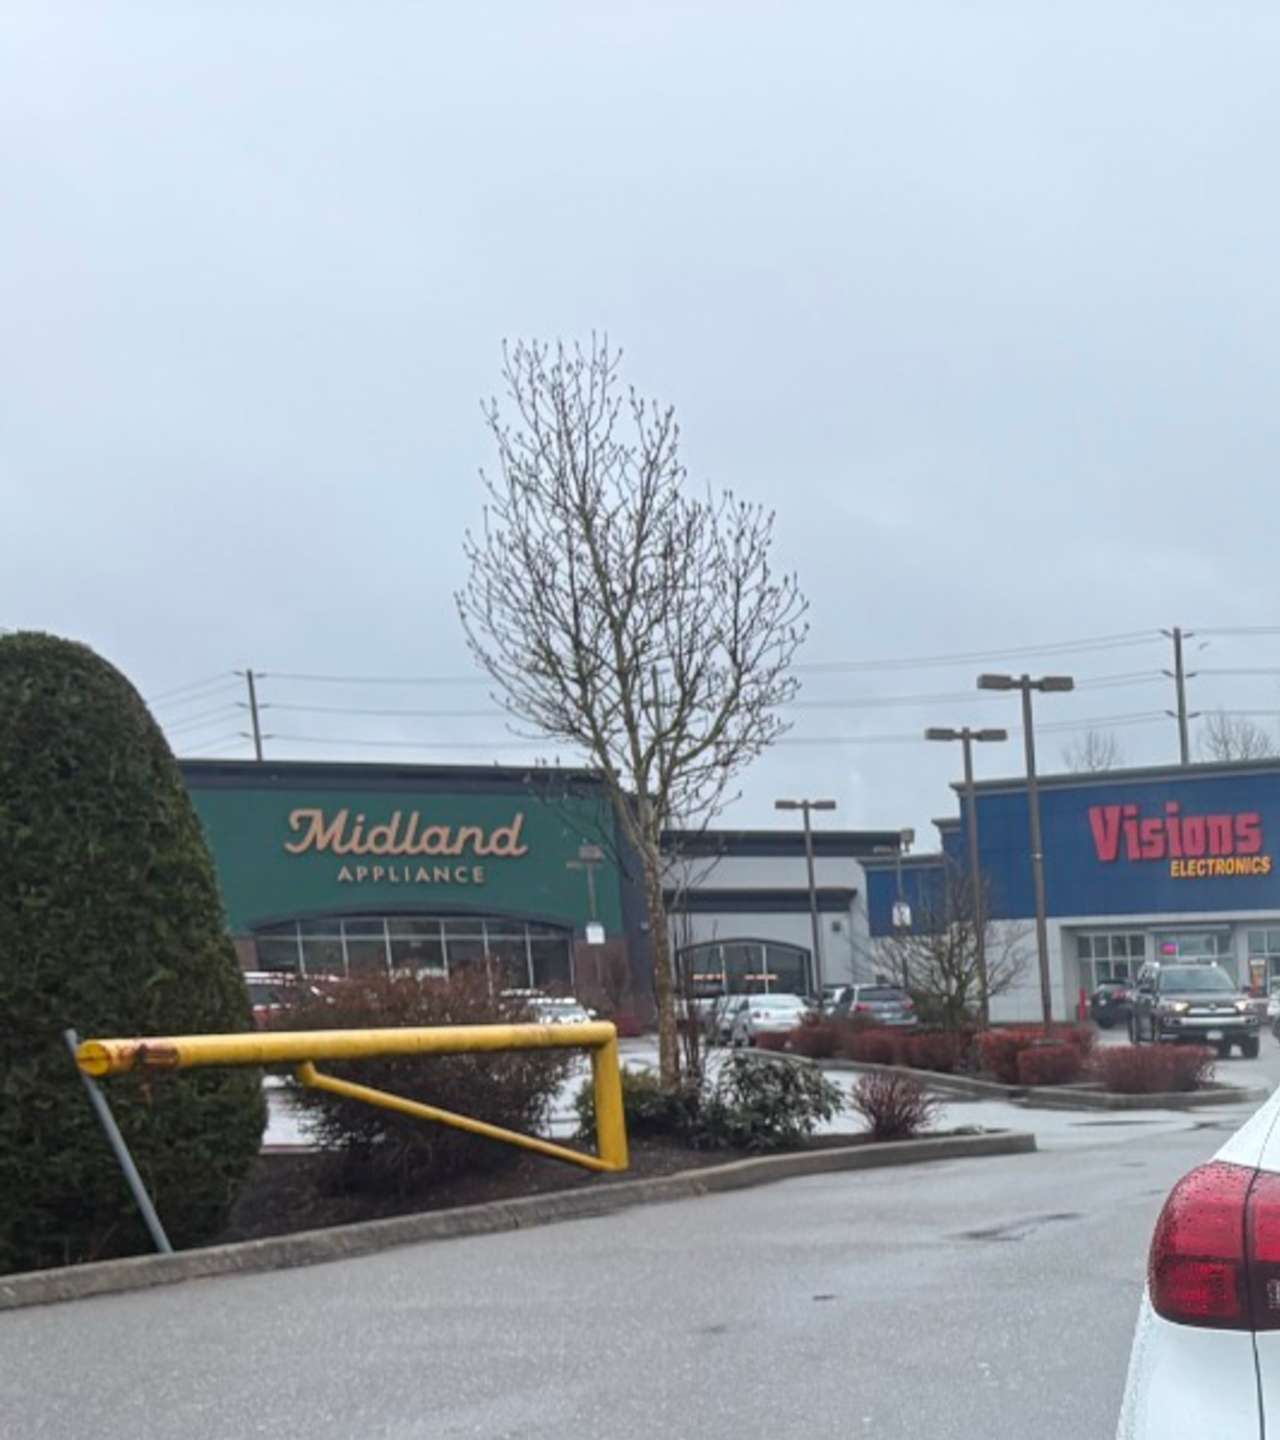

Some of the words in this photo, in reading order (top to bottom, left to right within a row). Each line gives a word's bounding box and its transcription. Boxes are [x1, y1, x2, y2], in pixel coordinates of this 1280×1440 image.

[284, 808, 528, 857] Midland
[1089, 802, 1264, 861] Visions
[337, 866, 486, 883] APPLIANCE
[1170, 857, 1272, 879] ELECTRONICS
